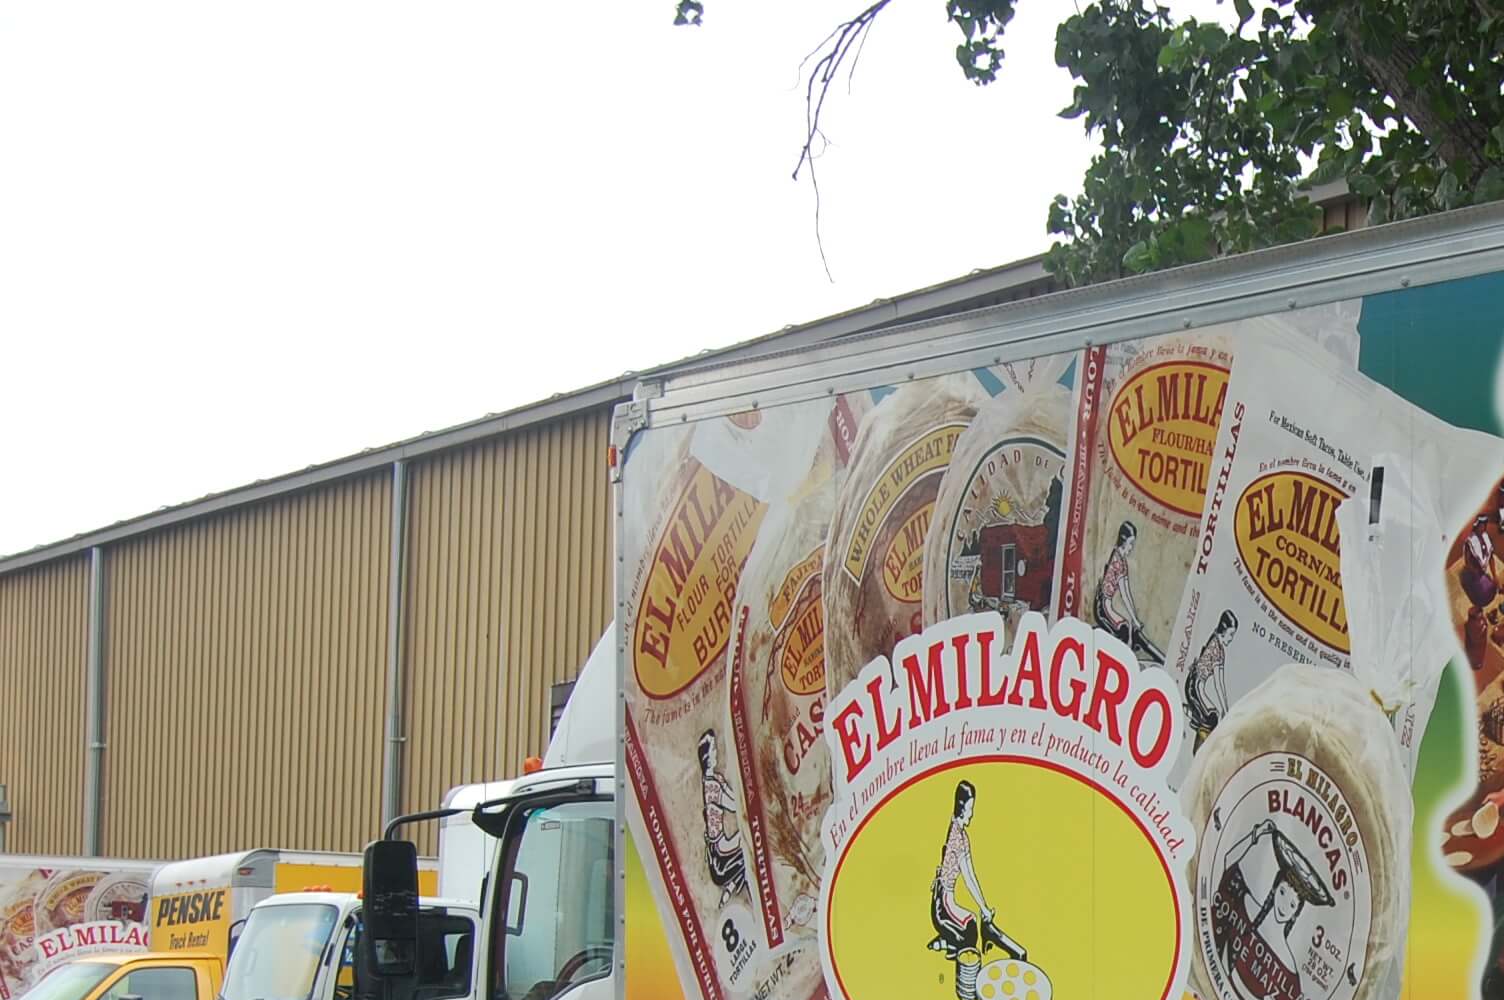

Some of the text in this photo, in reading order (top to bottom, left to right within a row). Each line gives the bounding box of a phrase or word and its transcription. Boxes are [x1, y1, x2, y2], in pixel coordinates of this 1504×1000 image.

[1269, 410, 1281, 425] For
[1280, 414, 1304, 440] Mexican
[1304, 428, 1318, 449] Soft
[850, 441, 943, 564] WHOLE WHEAT
[1197, 401, 1246, 575] TORTILLAS
[715, 557, 737, 593] FOR
[676, 574, 710, 632] FLOUR
[1251, 621, 1267, 639] NO
[1287, 758, 1303, 781] EL
[829, 721, 1186, 860] En el nombre lleva la fama y en el producto la calidad.
[1267, 789, 1348, 892] BLANCAS
[650, 806, 685, 911] TORTILLAS
[683, 912, 700, 947] FOR
[751, 815, 780, 943] TORTILLAS
[156, 890, 226, 928] PENSKE
[1200, 907, 1208, 928] DE
[1212, 892, 1248, 936] CORN
[169, 929, 210, 950] Truck Rental
[722, 918, 740, 953] 8
[730, 938, 748, 968] LARGE
[1312, 925, 1326, 949] 3
[729, 942, 757, 986] TORTILLAS
[771, 963, 786, 992] WT.
[1202, 930, 1224, 992] PRIMERA
[1233, 936, 1282, 1000] DE MAIZ
